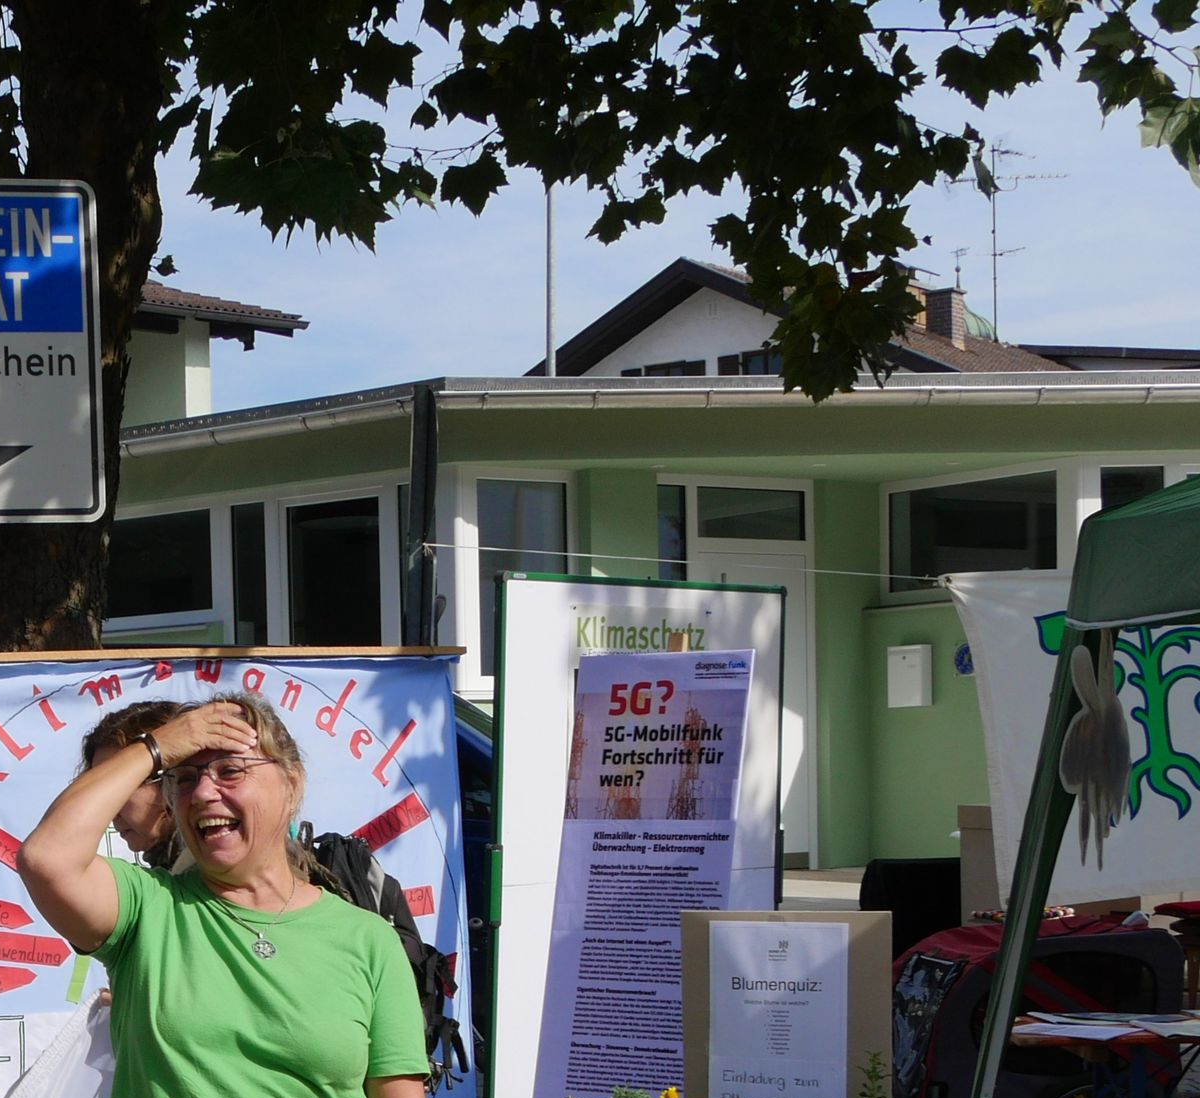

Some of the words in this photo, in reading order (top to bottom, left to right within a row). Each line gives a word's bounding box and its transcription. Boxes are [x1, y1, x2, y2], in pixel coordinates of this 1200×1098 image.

[577, 616, 705, 650] Klimaschtz
[607, 679, 676, 716] 5G?
[603, 724, 724, 743] 5G-Mobilfunk
[697, 747, 725, 764] für
[599, 769, 645, 788] wen?
[593, 832, 636, 840] Klimakiller
[592, 842, 646, 854] Überwachung
[653, 844, 705, 855] Elektrosmog
[731, 976, 823, 994] Blumenquiz:
[722, 1069, 785, 1091] Einladung
